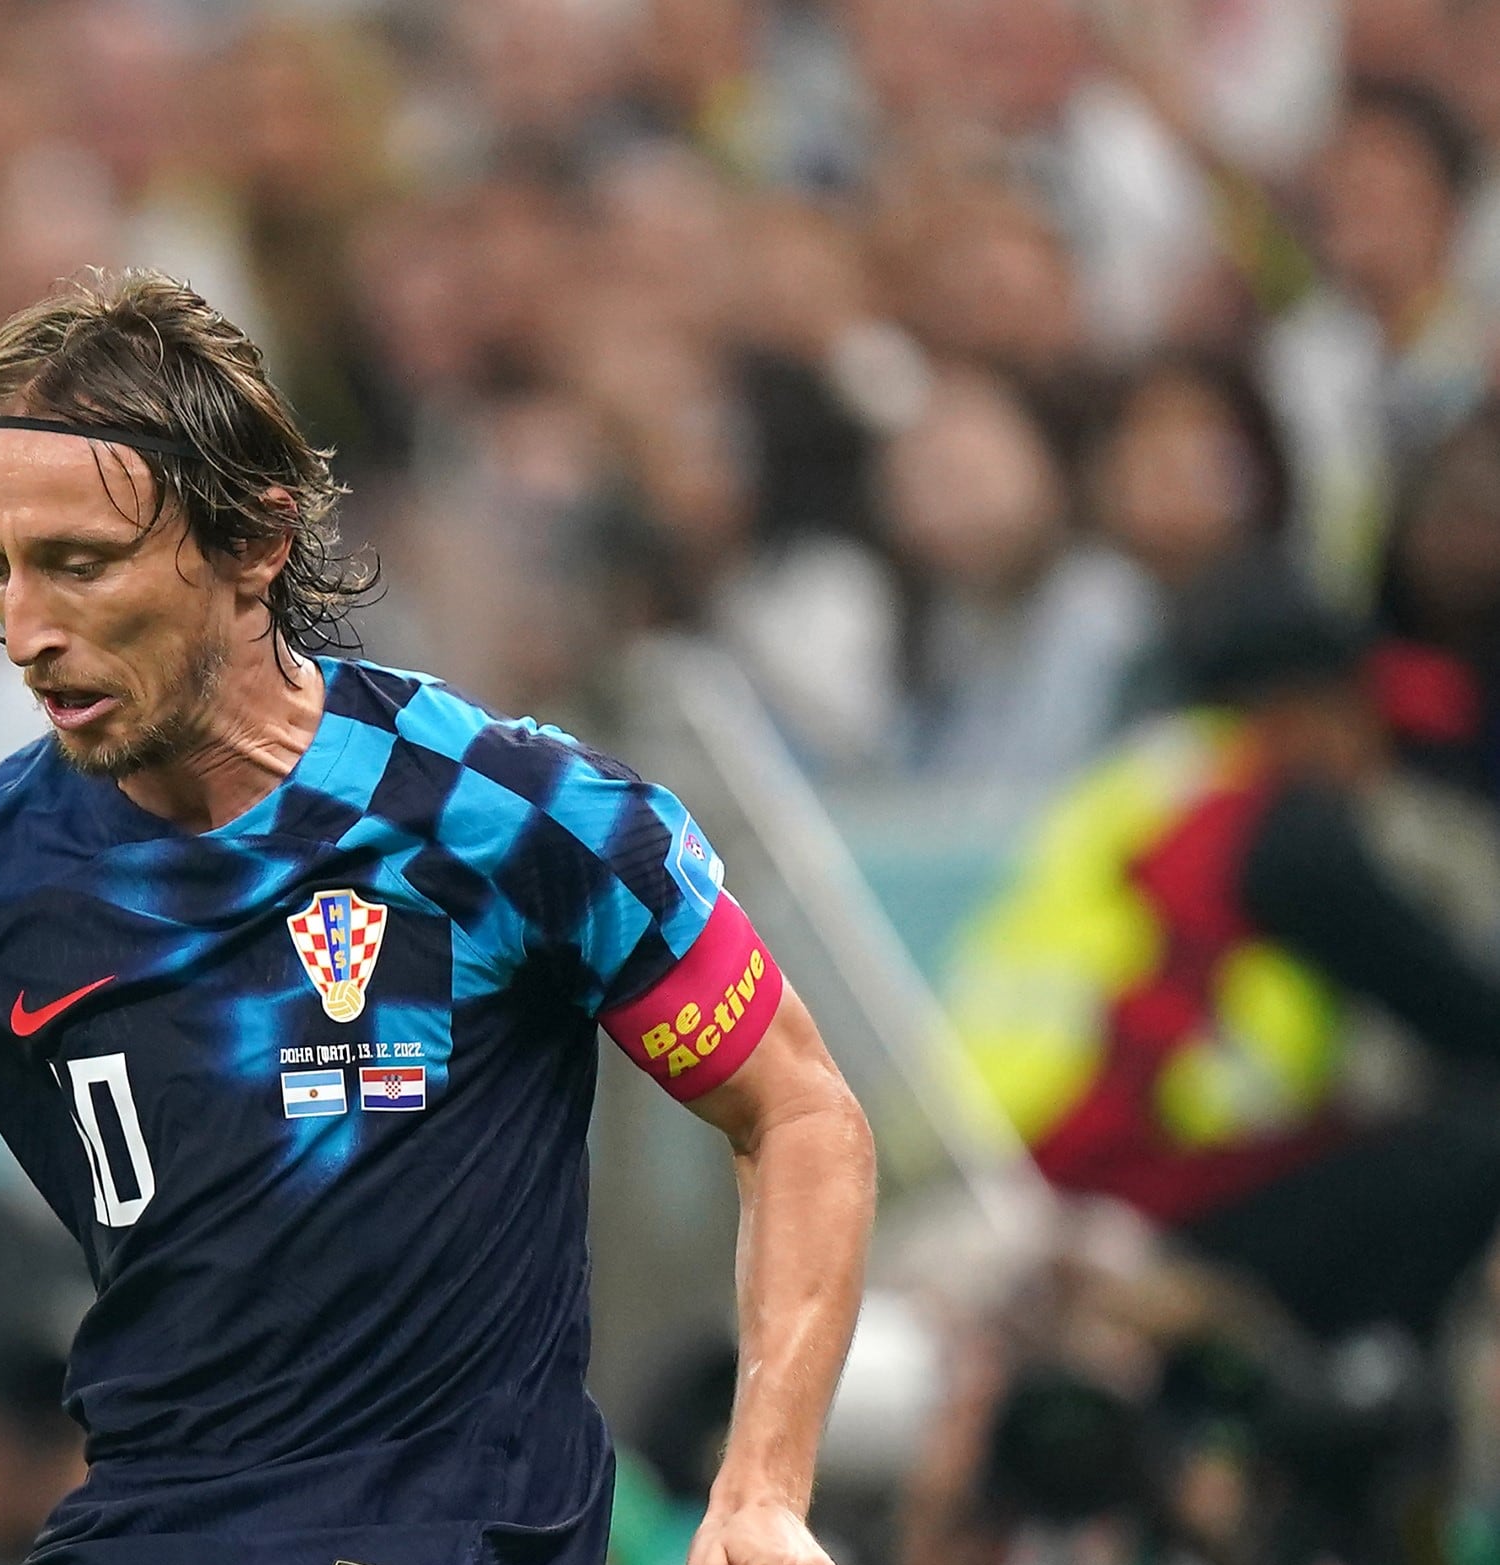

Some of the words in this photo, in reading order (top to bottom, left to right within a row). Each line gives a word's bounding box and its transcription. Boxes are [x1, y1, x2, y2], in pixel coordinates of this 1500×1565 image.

[327, 903, 348, 970] HNS
[641, 1000, 702, 1060] Be
[667, 947, 766, 1079] Active
[279, 1047, 314, 1064] DOHA
[46, 1052, 156, 1228] 0
